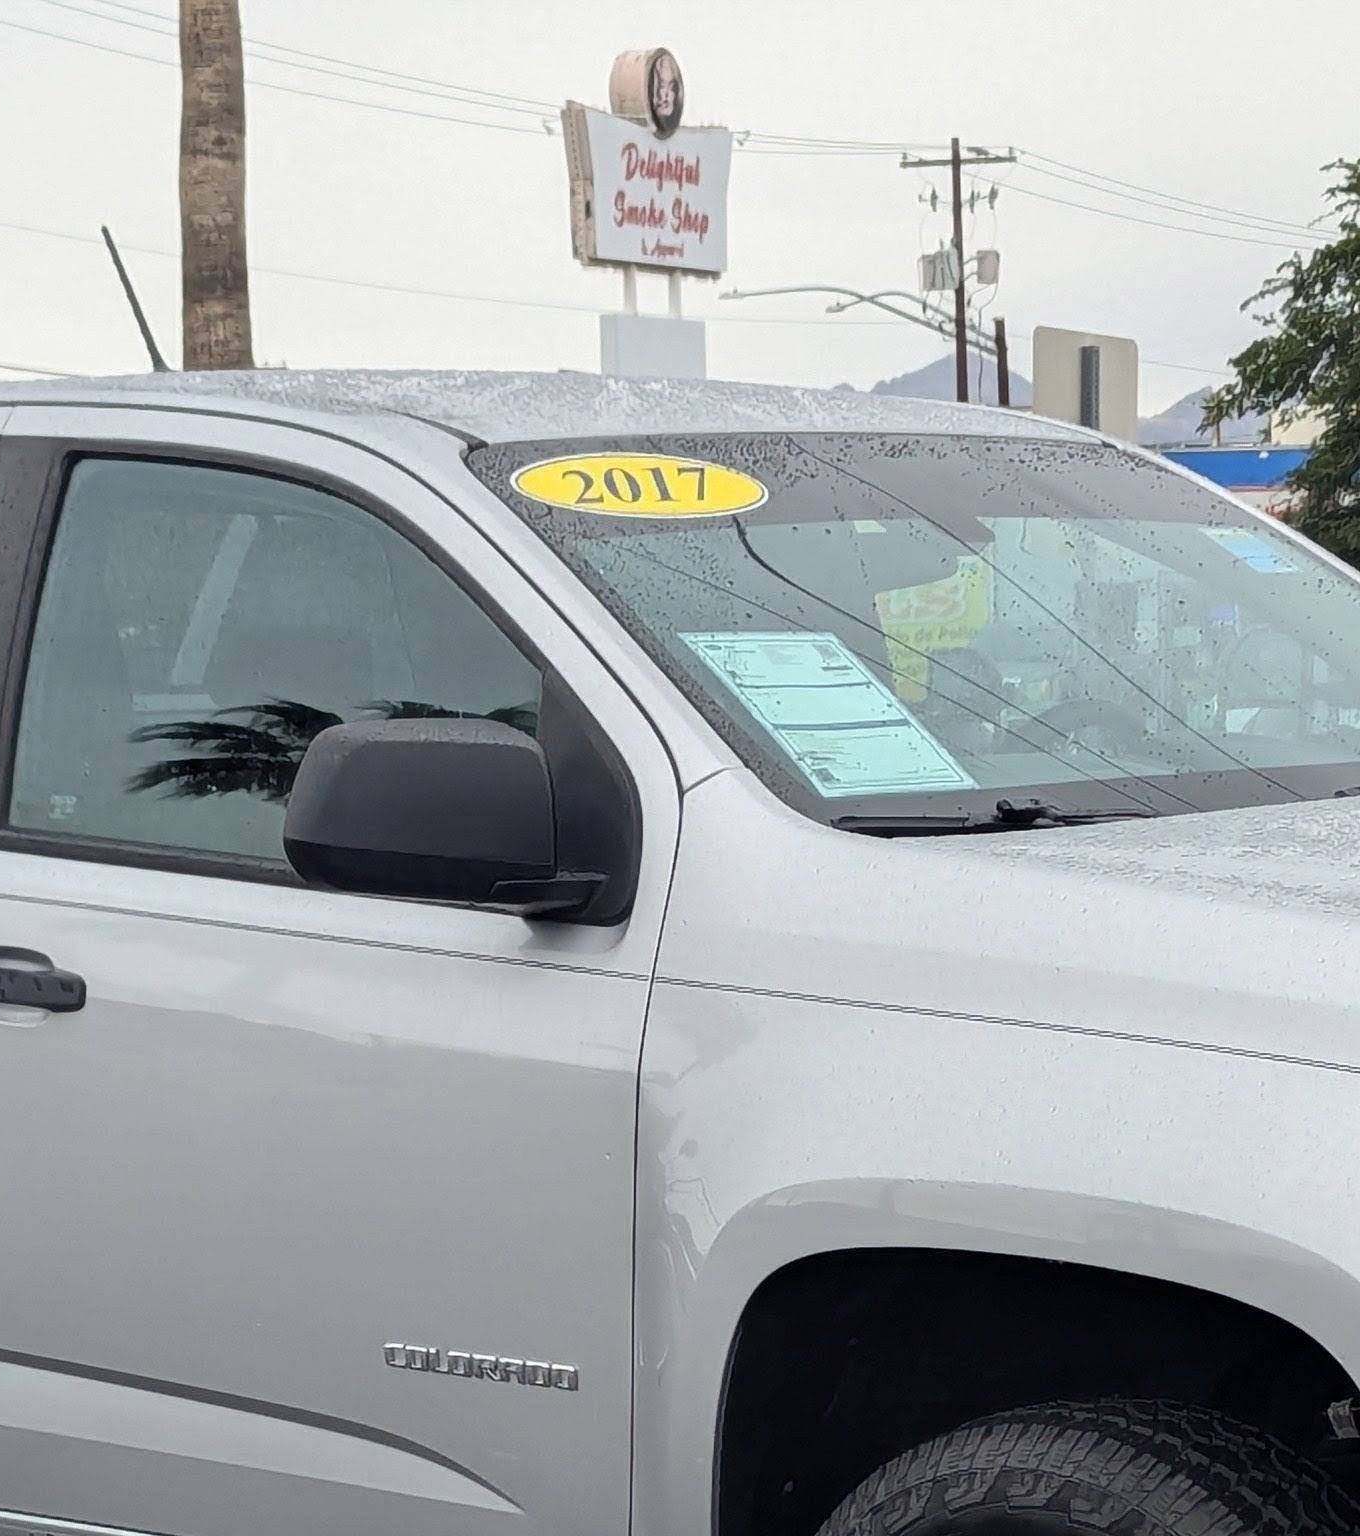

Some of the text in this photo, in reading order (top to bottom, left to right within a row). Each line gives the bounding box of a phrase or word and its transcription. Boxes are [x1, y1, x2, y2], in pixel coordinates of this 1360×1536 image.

[621, 142, 700, 192] Delightful
[613, 190, 709, 244] Smoke Shop
[561, 466, 706, 505] 2017
[382, 1342, 579, 1391] COLORADO
